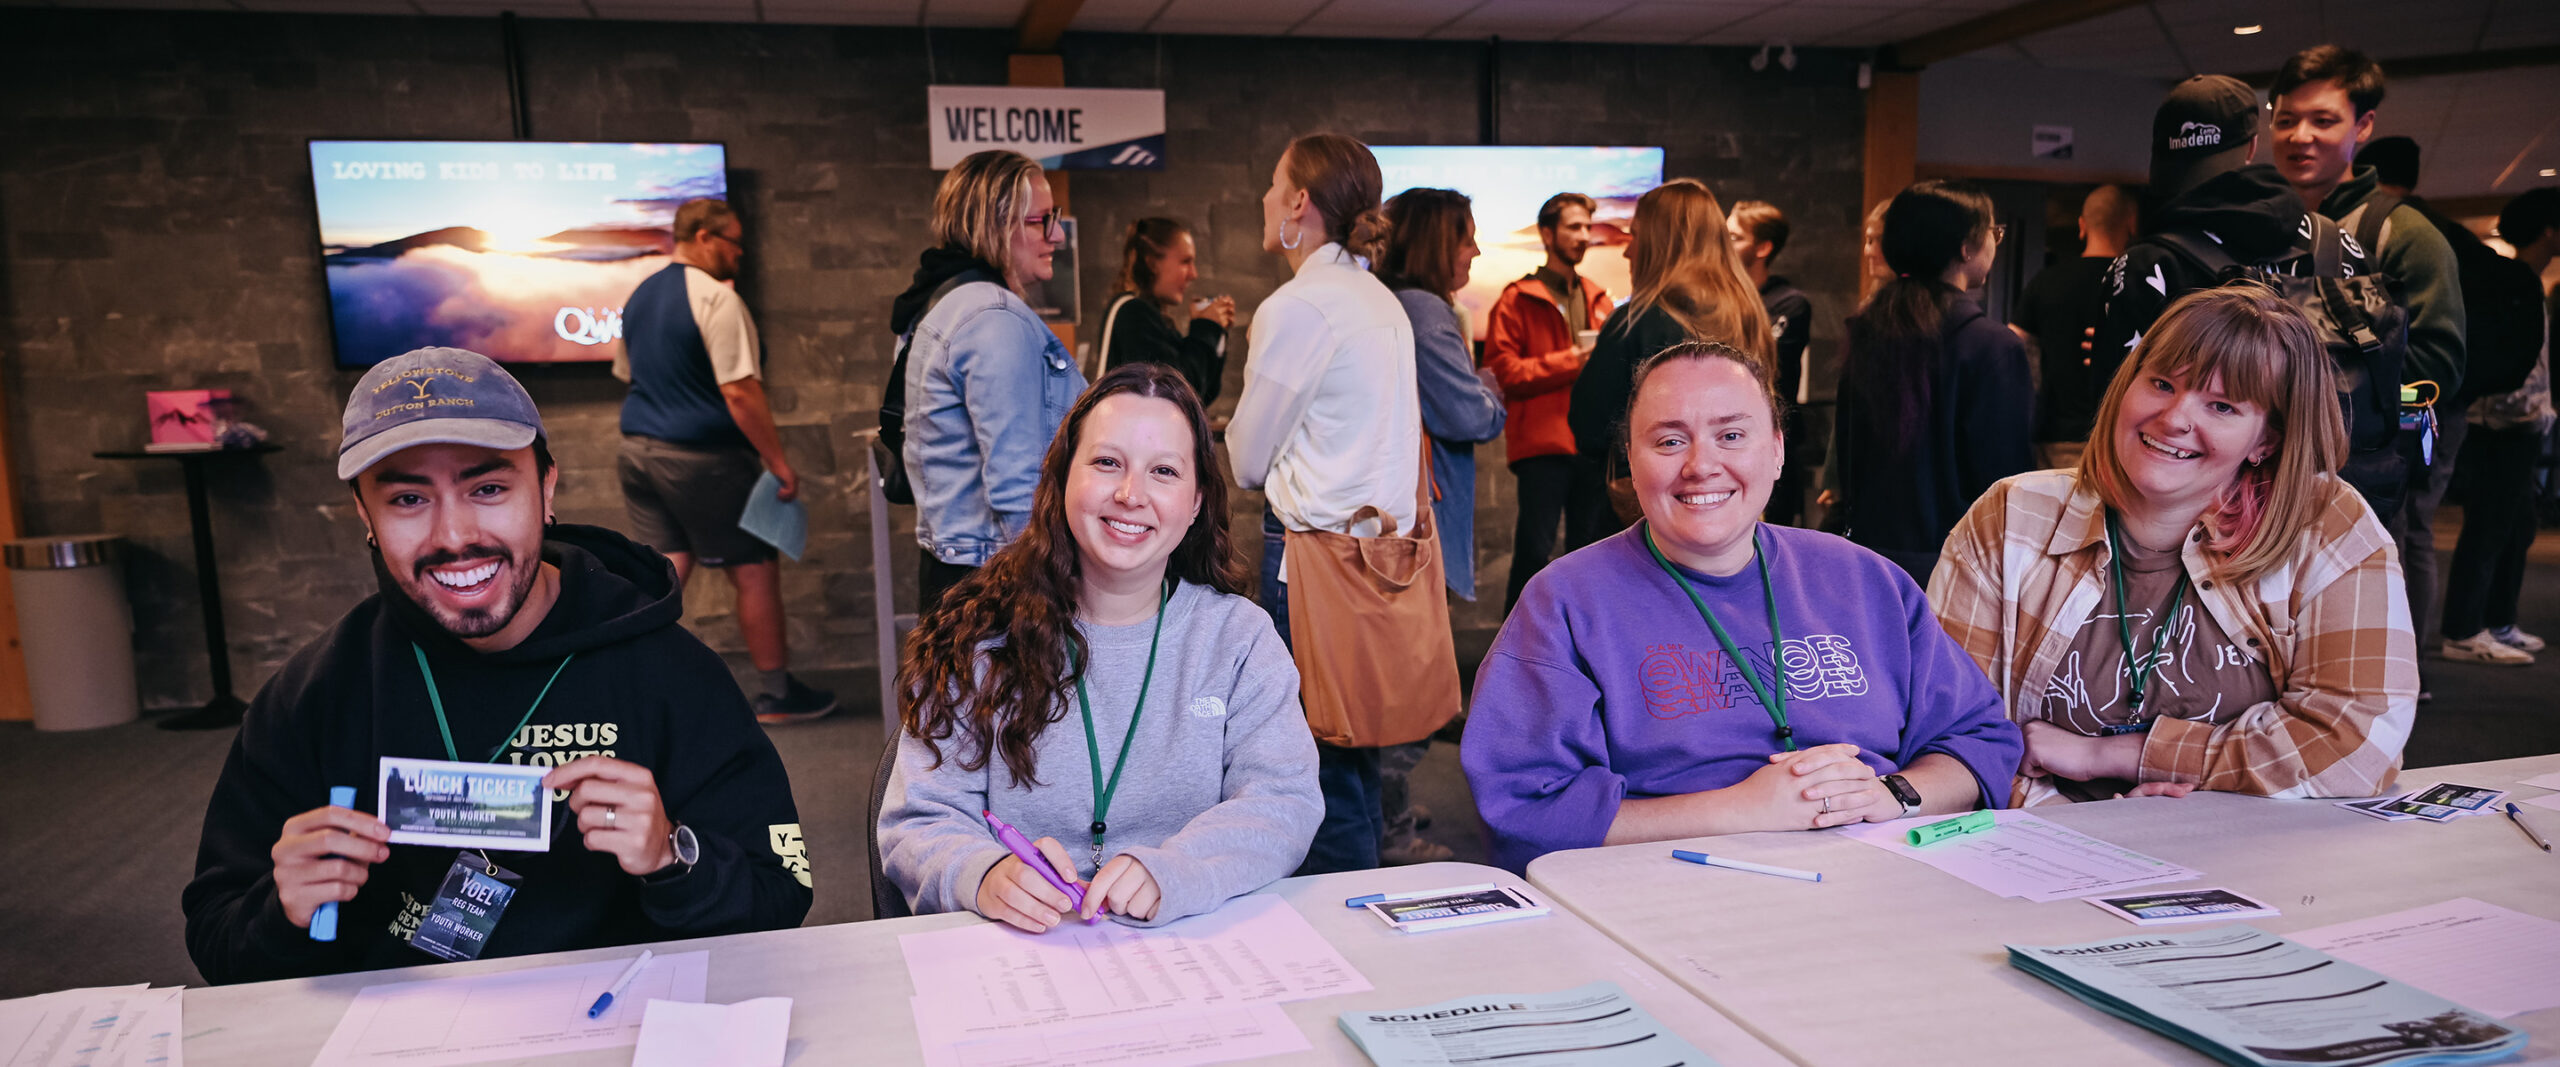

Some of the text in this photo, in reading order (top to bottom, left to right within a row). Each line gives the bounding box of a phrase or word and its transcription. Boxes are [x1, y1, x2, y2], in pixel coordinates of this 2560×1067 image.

[945, 106, 1083, 143] WELCOME
[2199, 128, 2216, 136] Camp
[2169, 133, 2221, 150] Imadene
[332, 161, 617, 182] LOVING KIDS TO LIFE
[372, 367, 475, 395] YELLOWSTONE
[375, 398, 475, 420] DUTTON RANCH
[1645, 643, 1685, 654] CAMP
[510, 722, 619, 748] JESUS
[404, 771, 526, 796] LUNCH TICKET
[429, 807, 497, 823] YOUTH WORKER
[459, 876, 498, 907] YOEL
[451, 897, 486, 918] REG TEAM
[1405, 902, 1507, 920] LUNCH TICKET
[430, 912, 453, 930] YOUTH
[453, 923, 484, 942] WORKER
[2041, 939, 2178, 956] SCHEDULE
[1368, 1002, 1528, 1023] SCHEDULE
